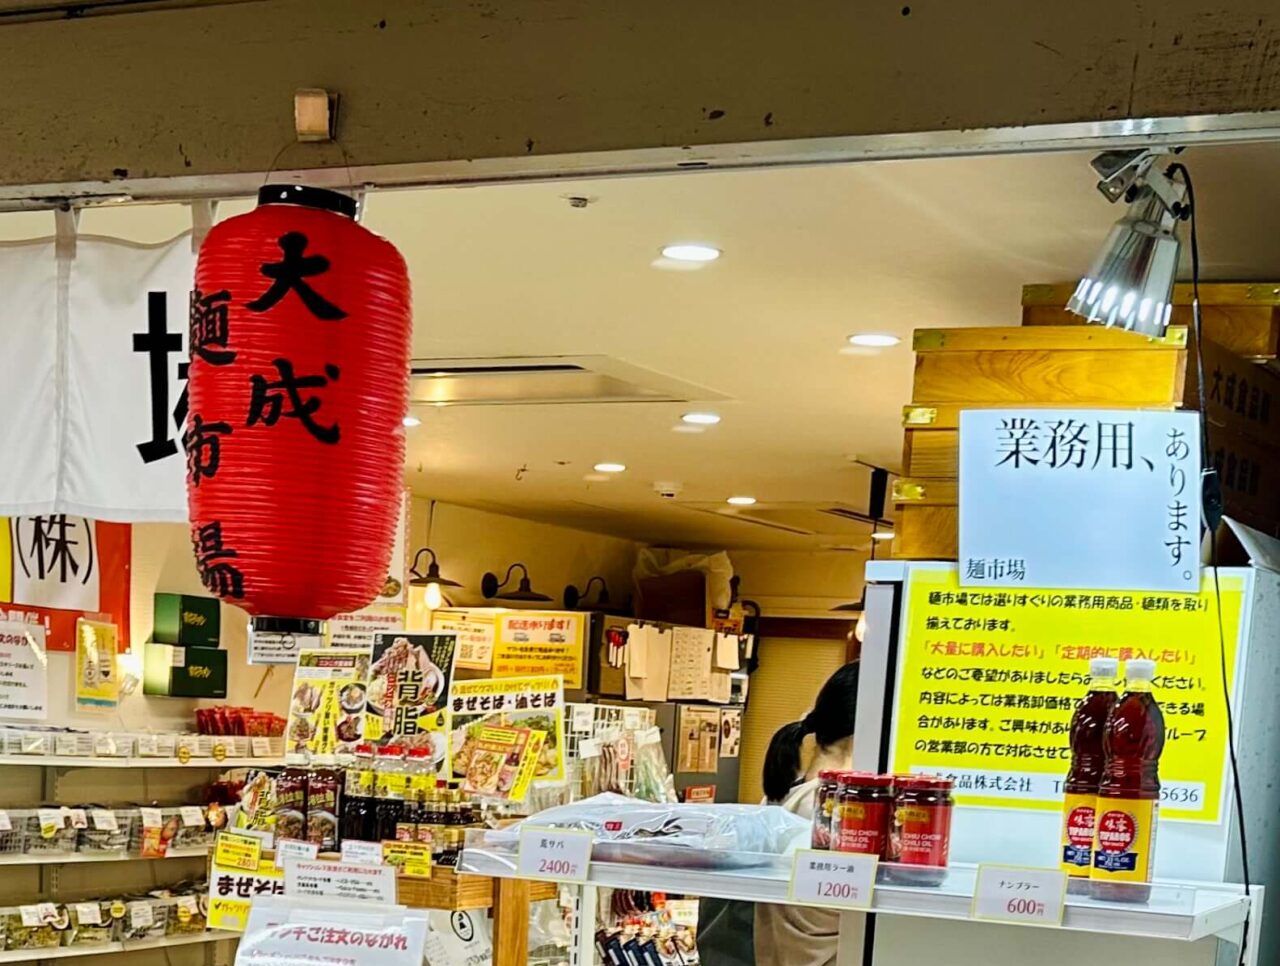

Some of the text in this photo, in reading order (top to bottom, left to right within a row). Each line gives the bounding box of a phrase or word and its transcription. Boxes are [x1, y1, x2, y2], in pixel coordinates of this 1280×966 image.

[246, 231, 348, 444] 大成
[995, 418, 1155, 473] 業務用、
[1163, 427, 1193, 581] あります。
[966, 558, 1027, 582] 麺市場
[926, 617, 1016, 637] 揃えております。
